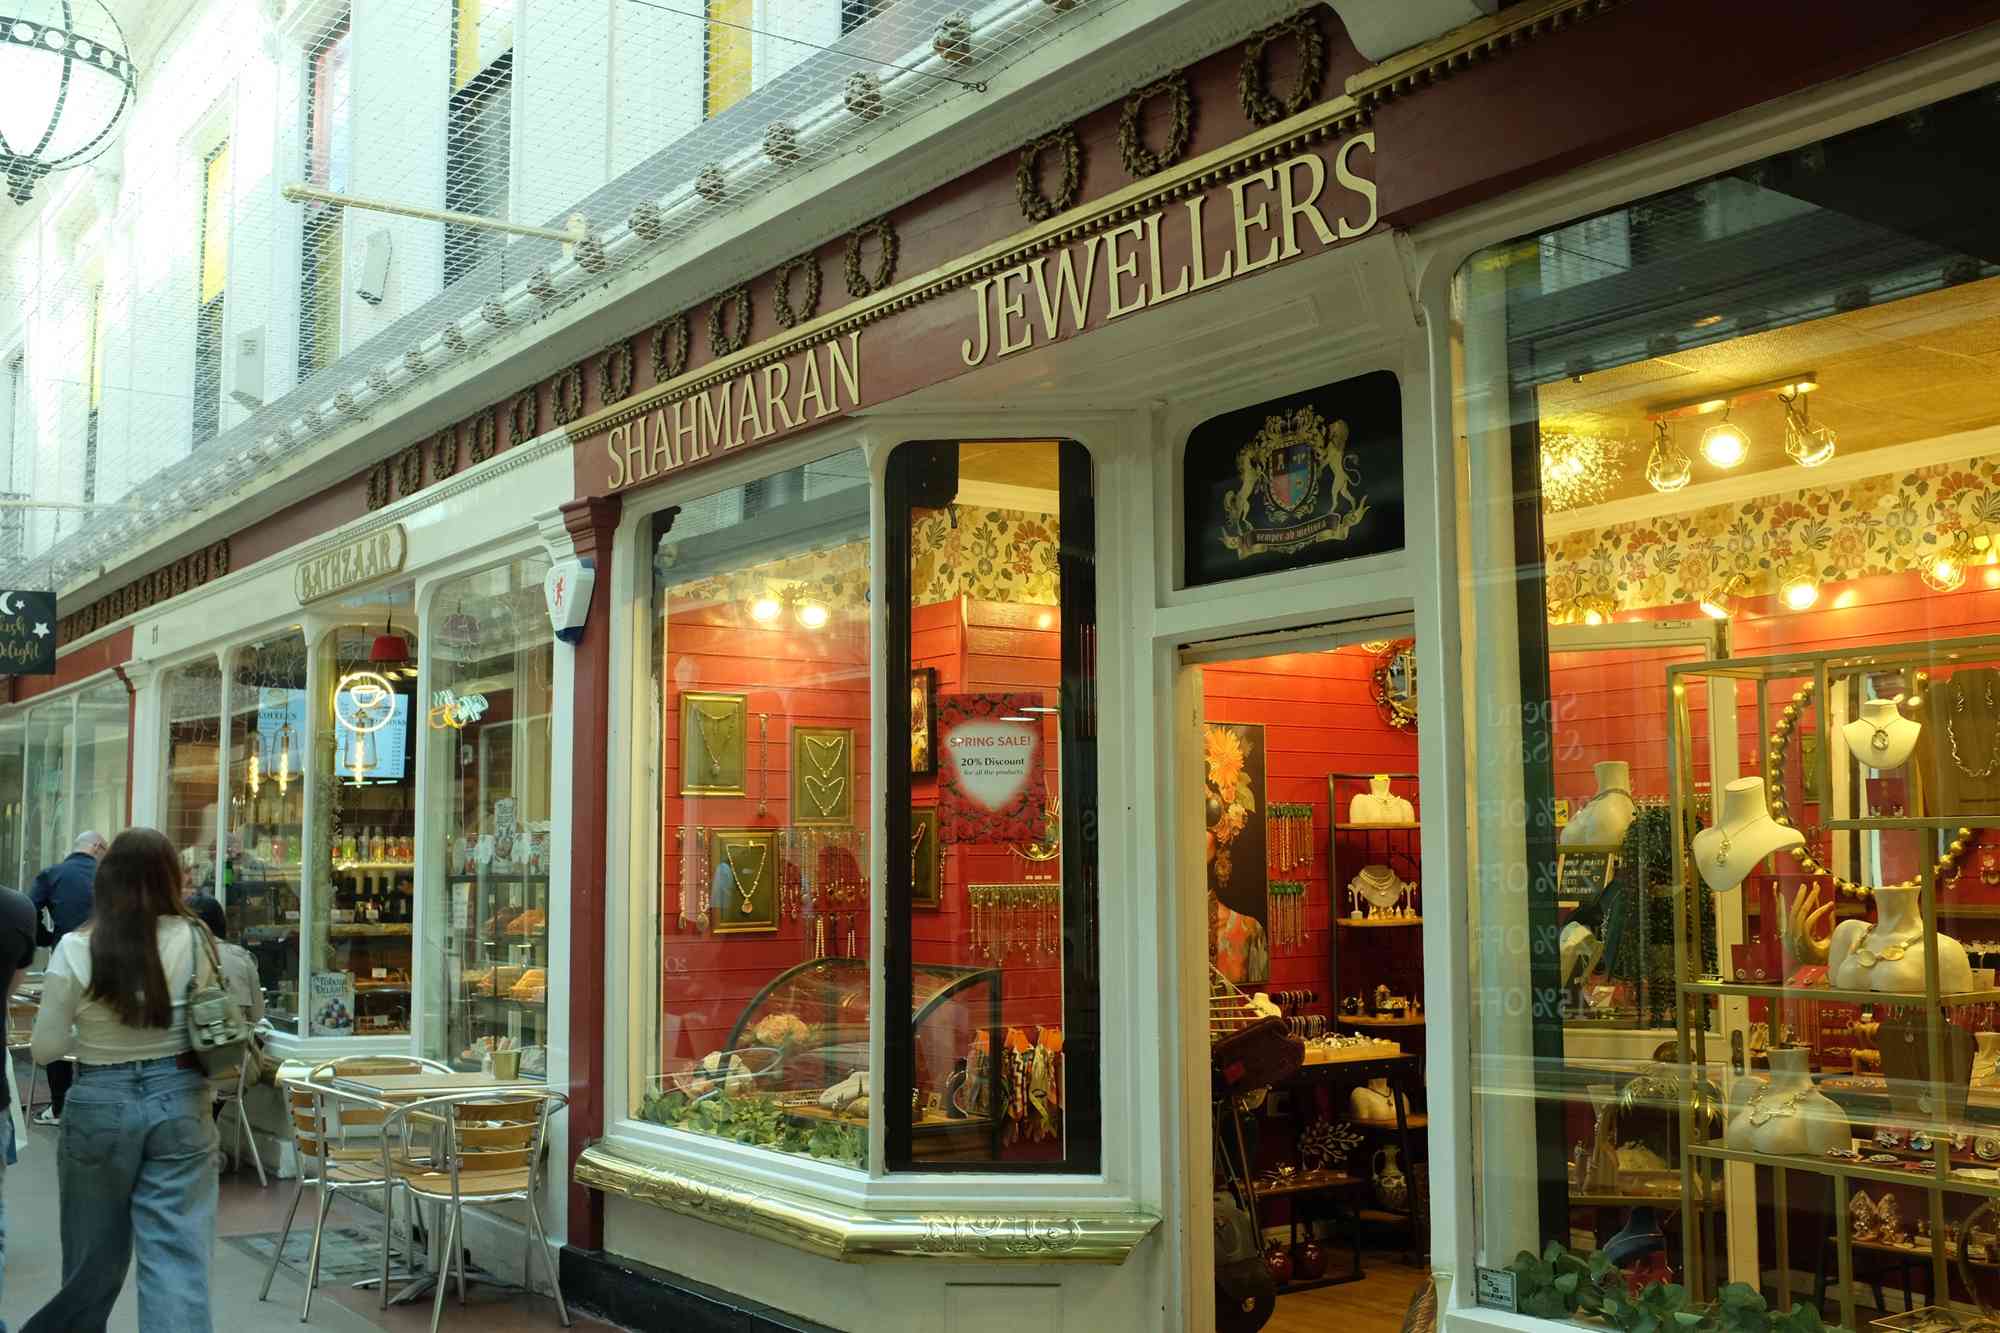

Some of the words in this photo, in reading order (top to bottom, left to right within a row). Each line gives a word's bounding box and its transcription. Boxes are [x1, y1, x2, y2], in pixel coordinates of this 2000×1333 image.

[607, 331, 862, 490] SHAHMARAN
[961, 131, 1379, 367] JEWELLERS
[302, 532, 392, 599] BATHZAAR
[950, 735, 994, 747] SPRING
[998, 735, 1031, 746] SALE!
[961, 757, 983, 767] 20%
[984, 757, 1024, 767] Discount
